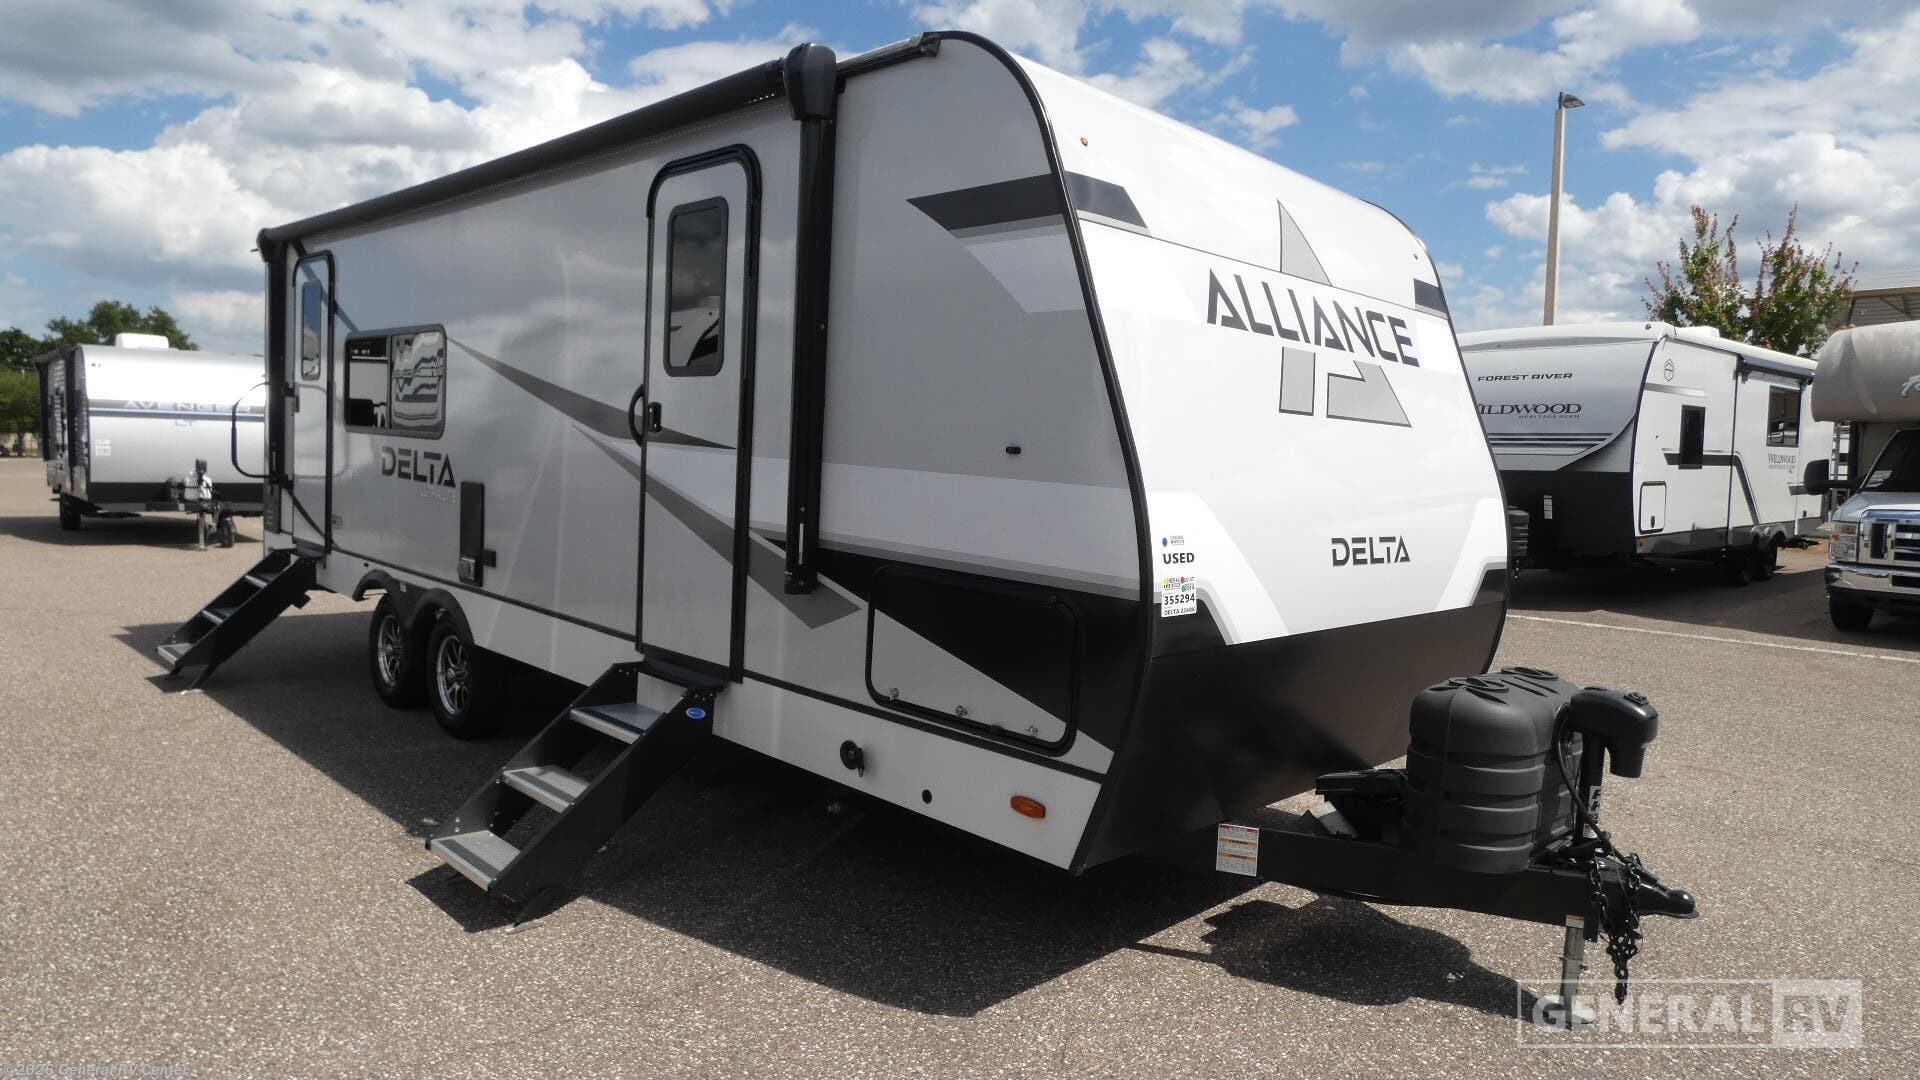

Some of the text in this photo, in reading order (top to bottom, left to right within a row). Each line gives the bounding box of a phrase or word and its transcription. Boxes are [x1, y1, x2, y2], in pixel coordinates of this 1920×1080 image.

[1206, 267, 1421, 368] ALLIANCE
[1477, 372, 1573, 382] FOREST RIVER
[1479, 403, 1582, 415] ILDWOOD
[381, 446, 456, 488] DELTA
[1331, 535, 1411, 567] DELTA
[1162, 552, 1195, 565] USED
[1163, 593, 1196, 606] 355294
[1163, 608, 1180, 616] DELTA
